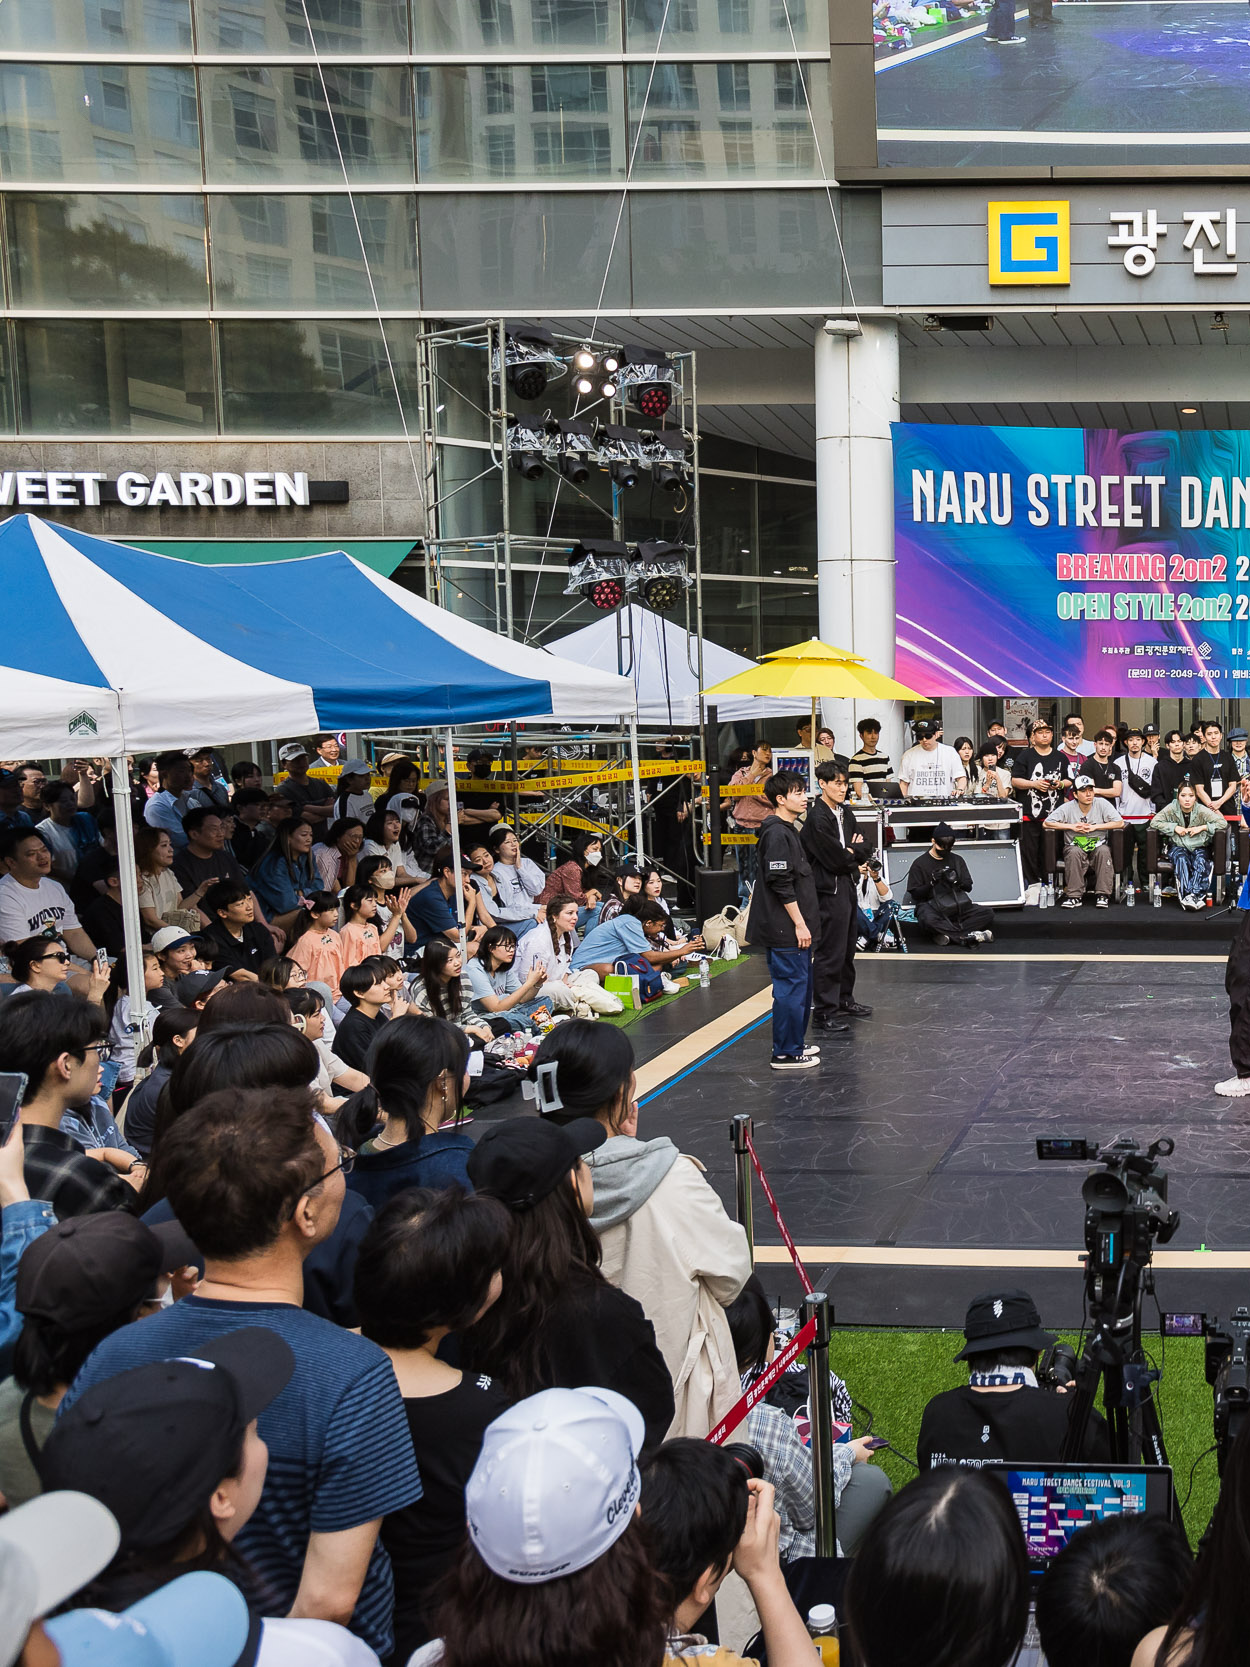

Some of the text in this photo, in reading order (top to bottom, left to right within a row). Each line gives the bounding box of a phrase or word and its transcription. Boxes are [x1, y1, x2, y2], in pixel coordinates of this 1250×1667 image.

[116, 472, 310, 506] GARDEN
[912, 469, 1012, 525] NARU
[1028, 474, 1166, 528] STREET
[1056, 553, 1166, 582] BREAKING
[1169, 554, 1228, 582] 2on2
[1056, 592, 1112, 620] OPEN
[1114, 592, 1176, 620] STYLE
[1177, 592, 1232, 621] 2on2
[1146, 646, 1194, 656] 광진문화재단
[1128, 669, 1152, 678] [문의]
[1154, 669, 1220, 678] 02-2049-4700
[683, 764, 702, 772] 출입금지
[550, 778, 572, 786] 출입금지
[596, 772, 618, 782] 출입금지
[1040, 1478, 1062, 1487] STREET
[1063, 1478, 1082, 1488] DANCE
[1084, 1478, 1112, 1488] FESTIVAL
